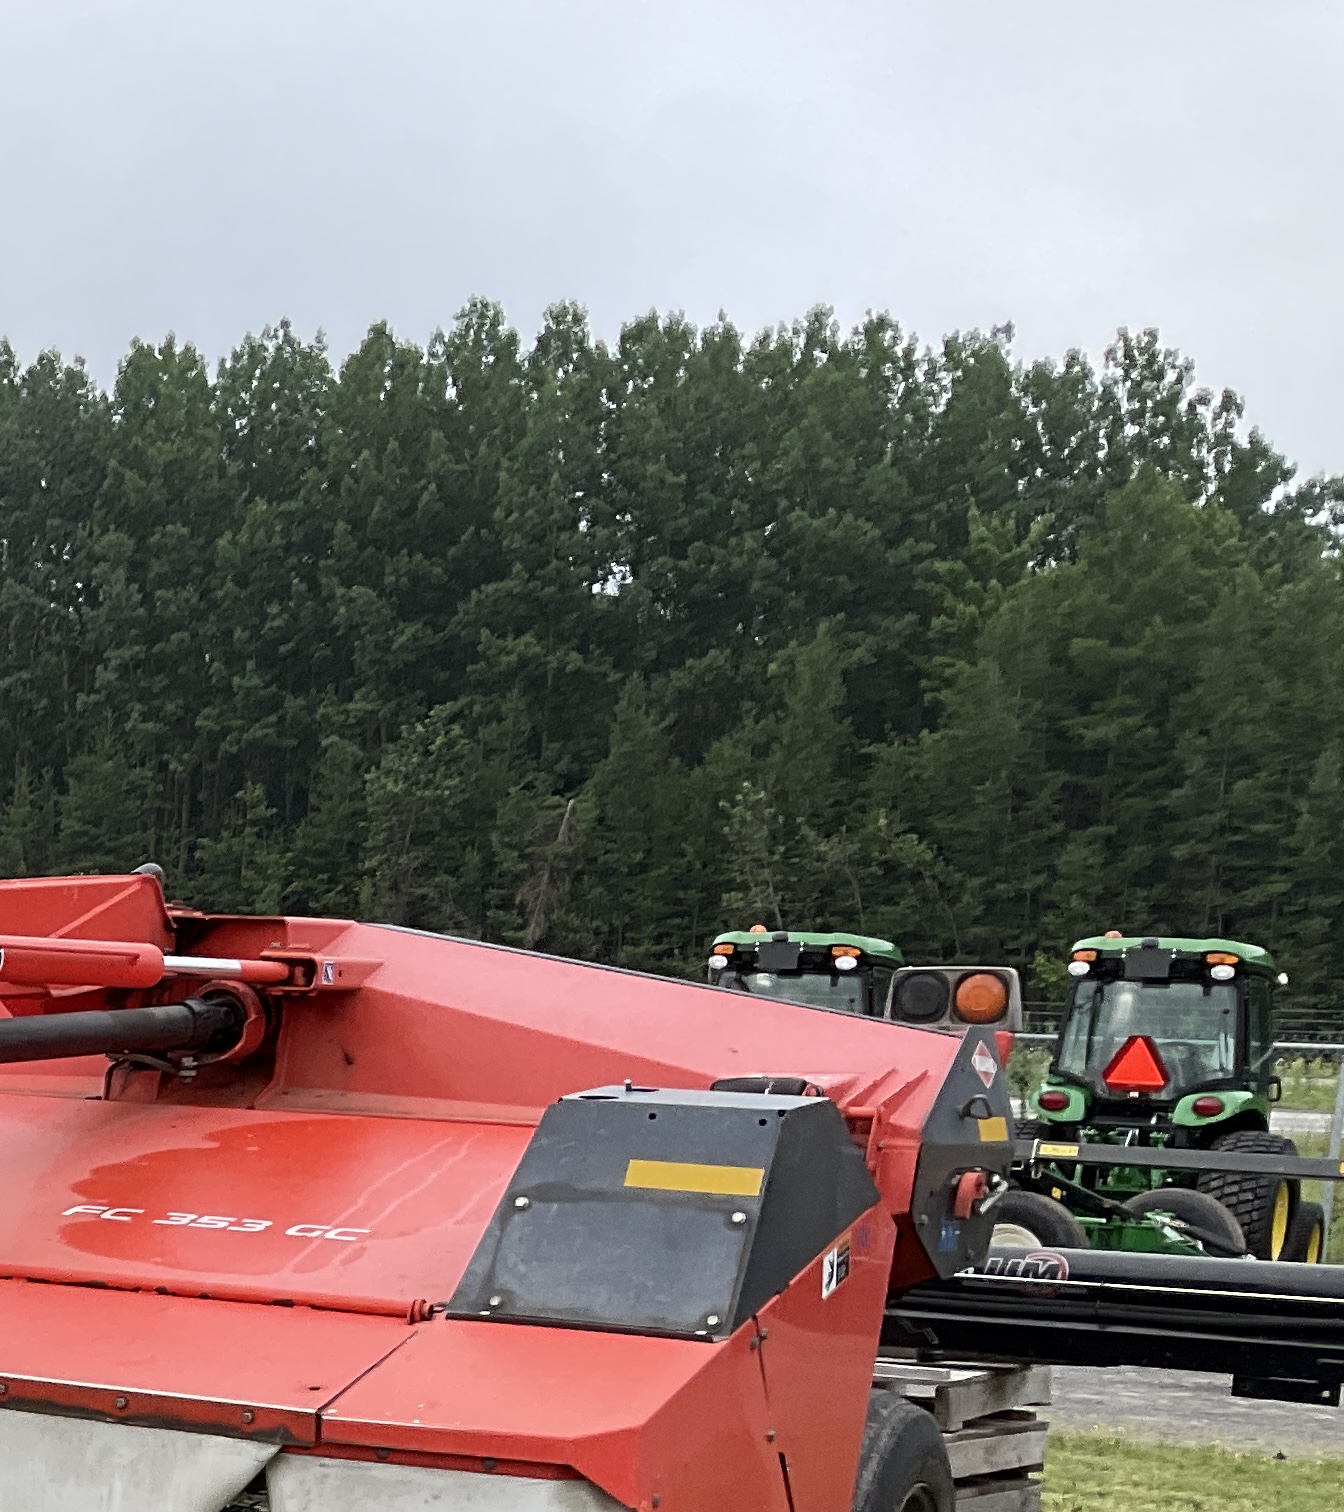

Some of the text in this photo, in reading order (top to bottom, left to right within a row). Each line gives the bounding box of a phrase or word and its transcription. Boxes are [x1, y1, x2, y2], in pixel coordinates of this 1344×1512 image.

[61, 1204, 373, 1241] FC 353 GC
